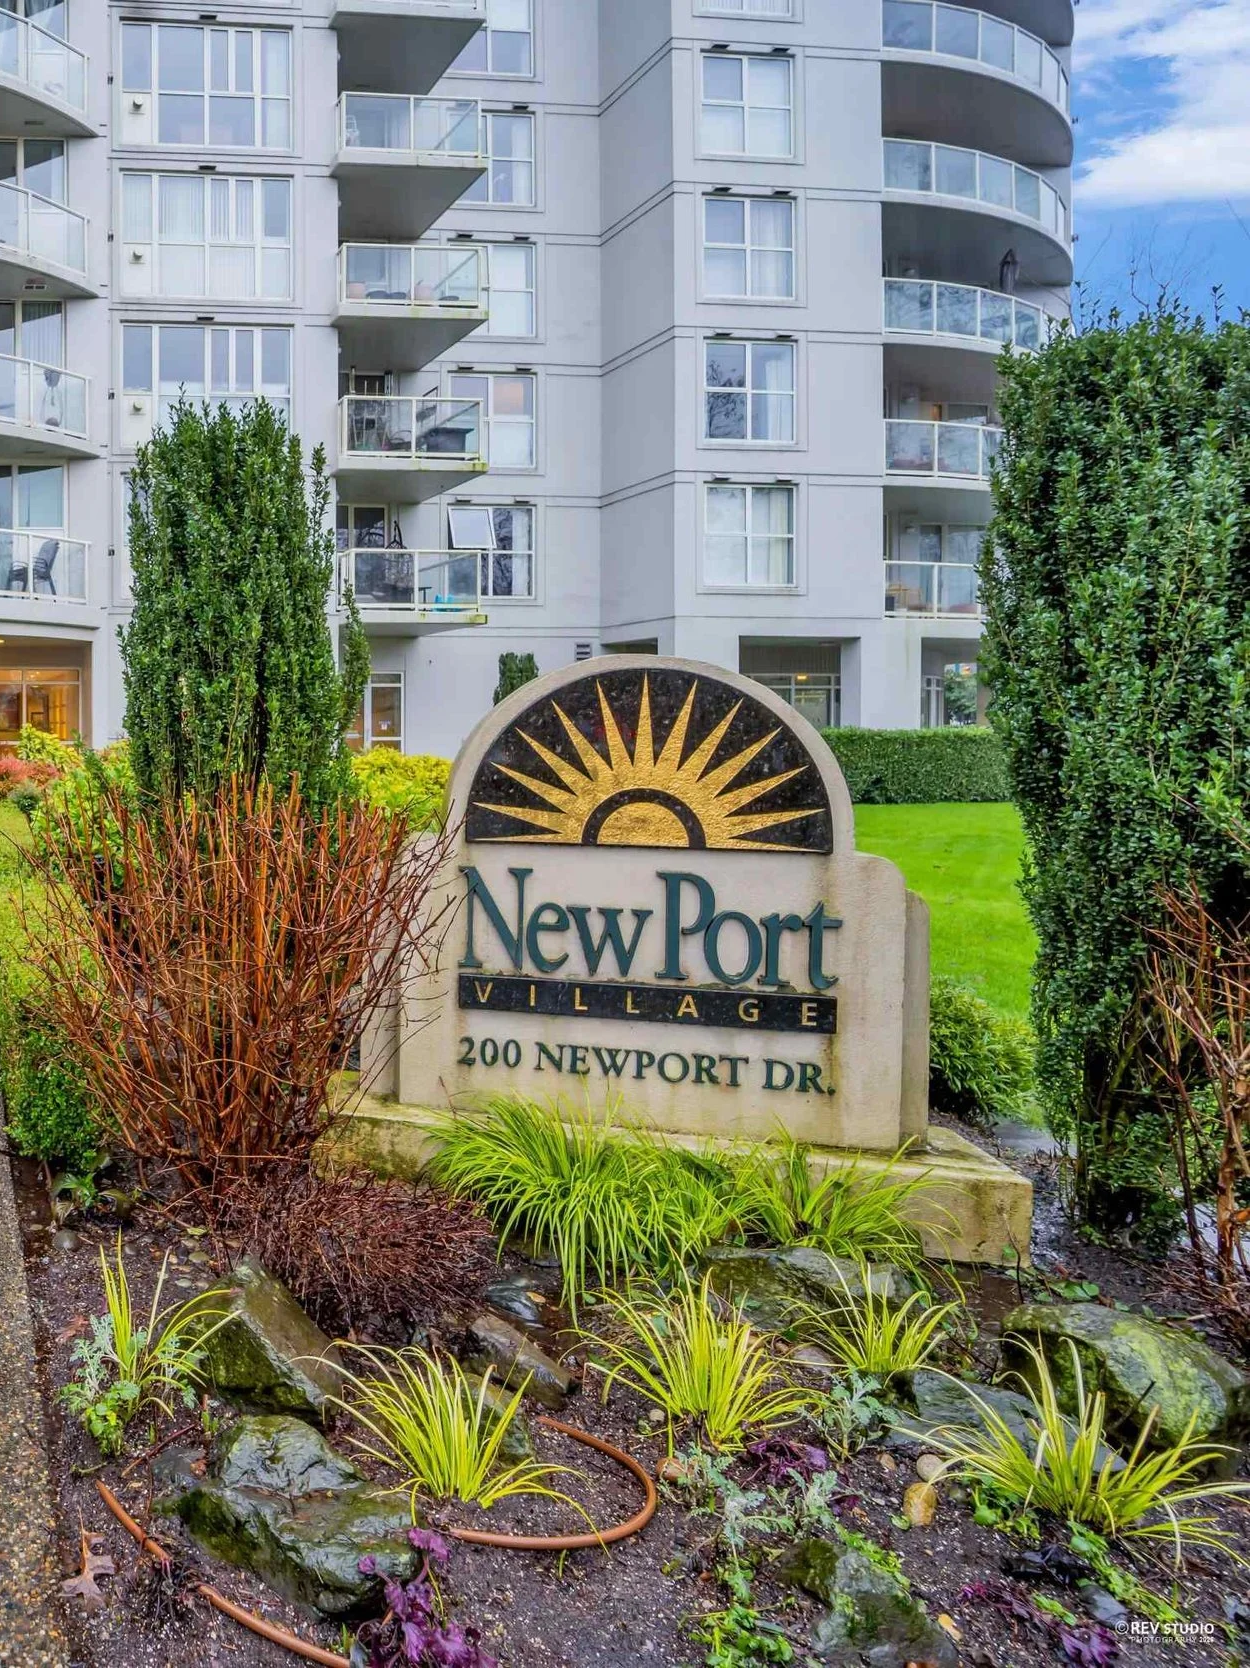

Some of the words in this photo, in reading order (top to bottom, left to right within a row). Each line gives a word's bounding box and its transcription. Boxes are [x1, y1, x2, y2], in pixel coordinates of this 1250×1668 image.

[474, 980, 818, 1027] VILLAGE
[457, 1036, 522, 1068] 200
[533, 1041, 749, 1088] NEWPORT
[762, 1057, 836, 1097] DR.
